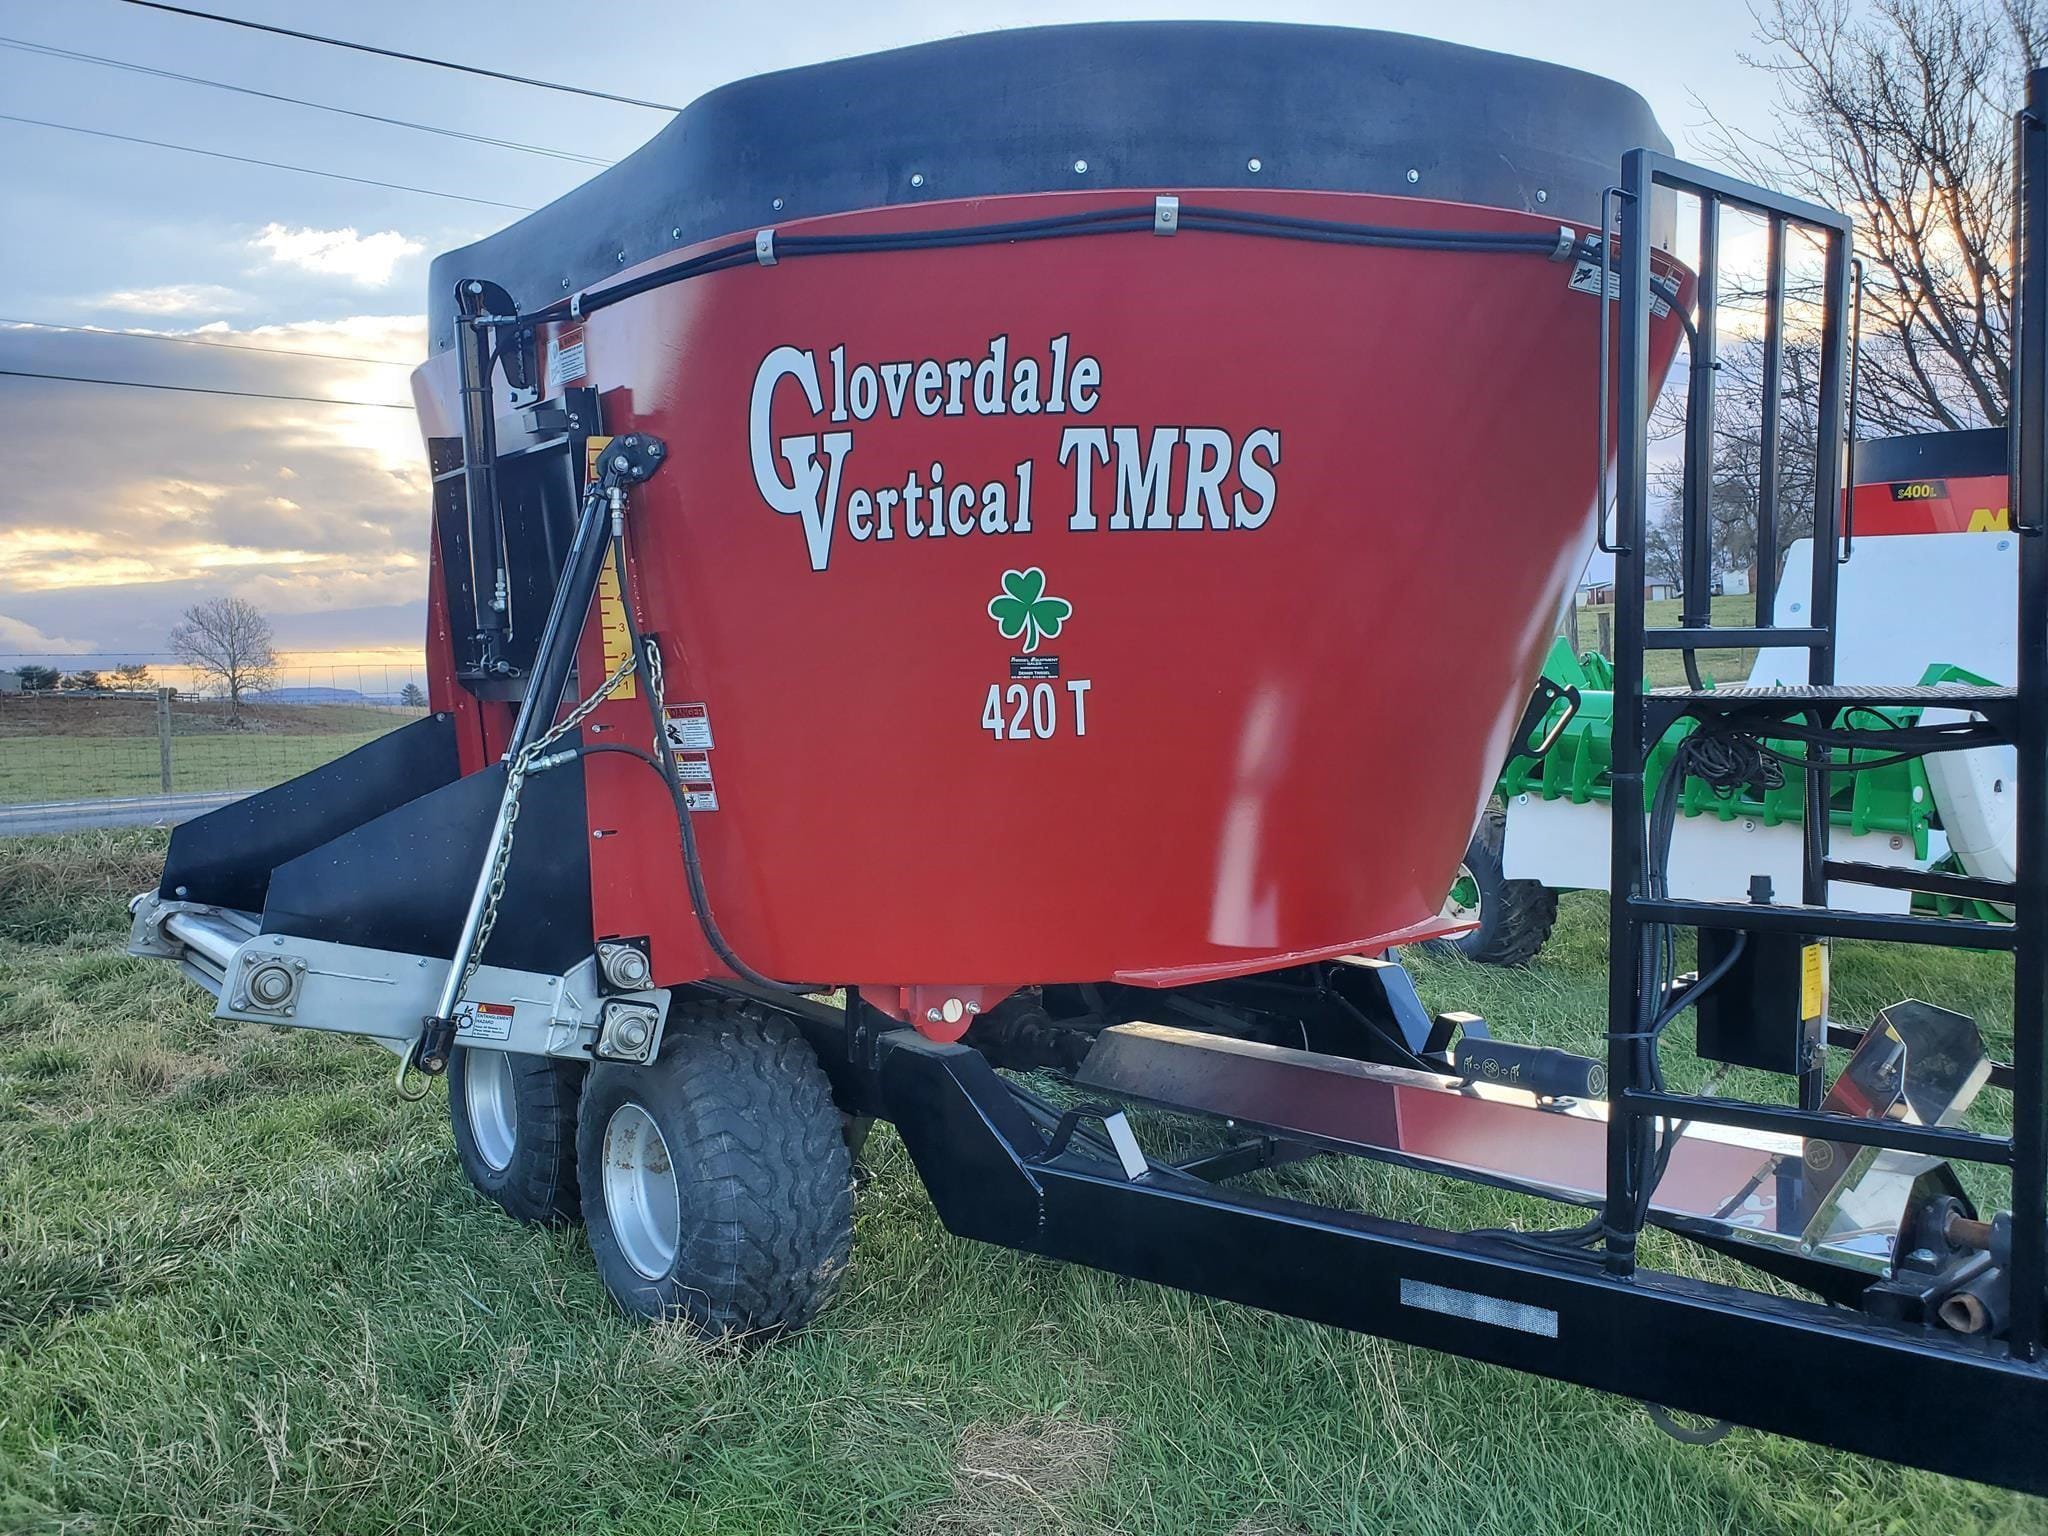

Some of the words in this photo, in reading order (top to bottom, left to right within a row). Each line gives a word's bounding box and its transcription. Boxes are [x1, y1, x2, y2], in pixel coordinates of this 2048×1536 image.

[750, 333, 1102, 515] Cloverdale
[779, 430, 1034, 571] Vertical
[1057, 425, 1282, 532] TMRS
[619, 623, 625, 632] 3
[621, 652, 627, 661] 2
[623, 681, 629, 690] 1
[982, 682, 1057, 741] 420
[1067, 680, 1092, 737] T
